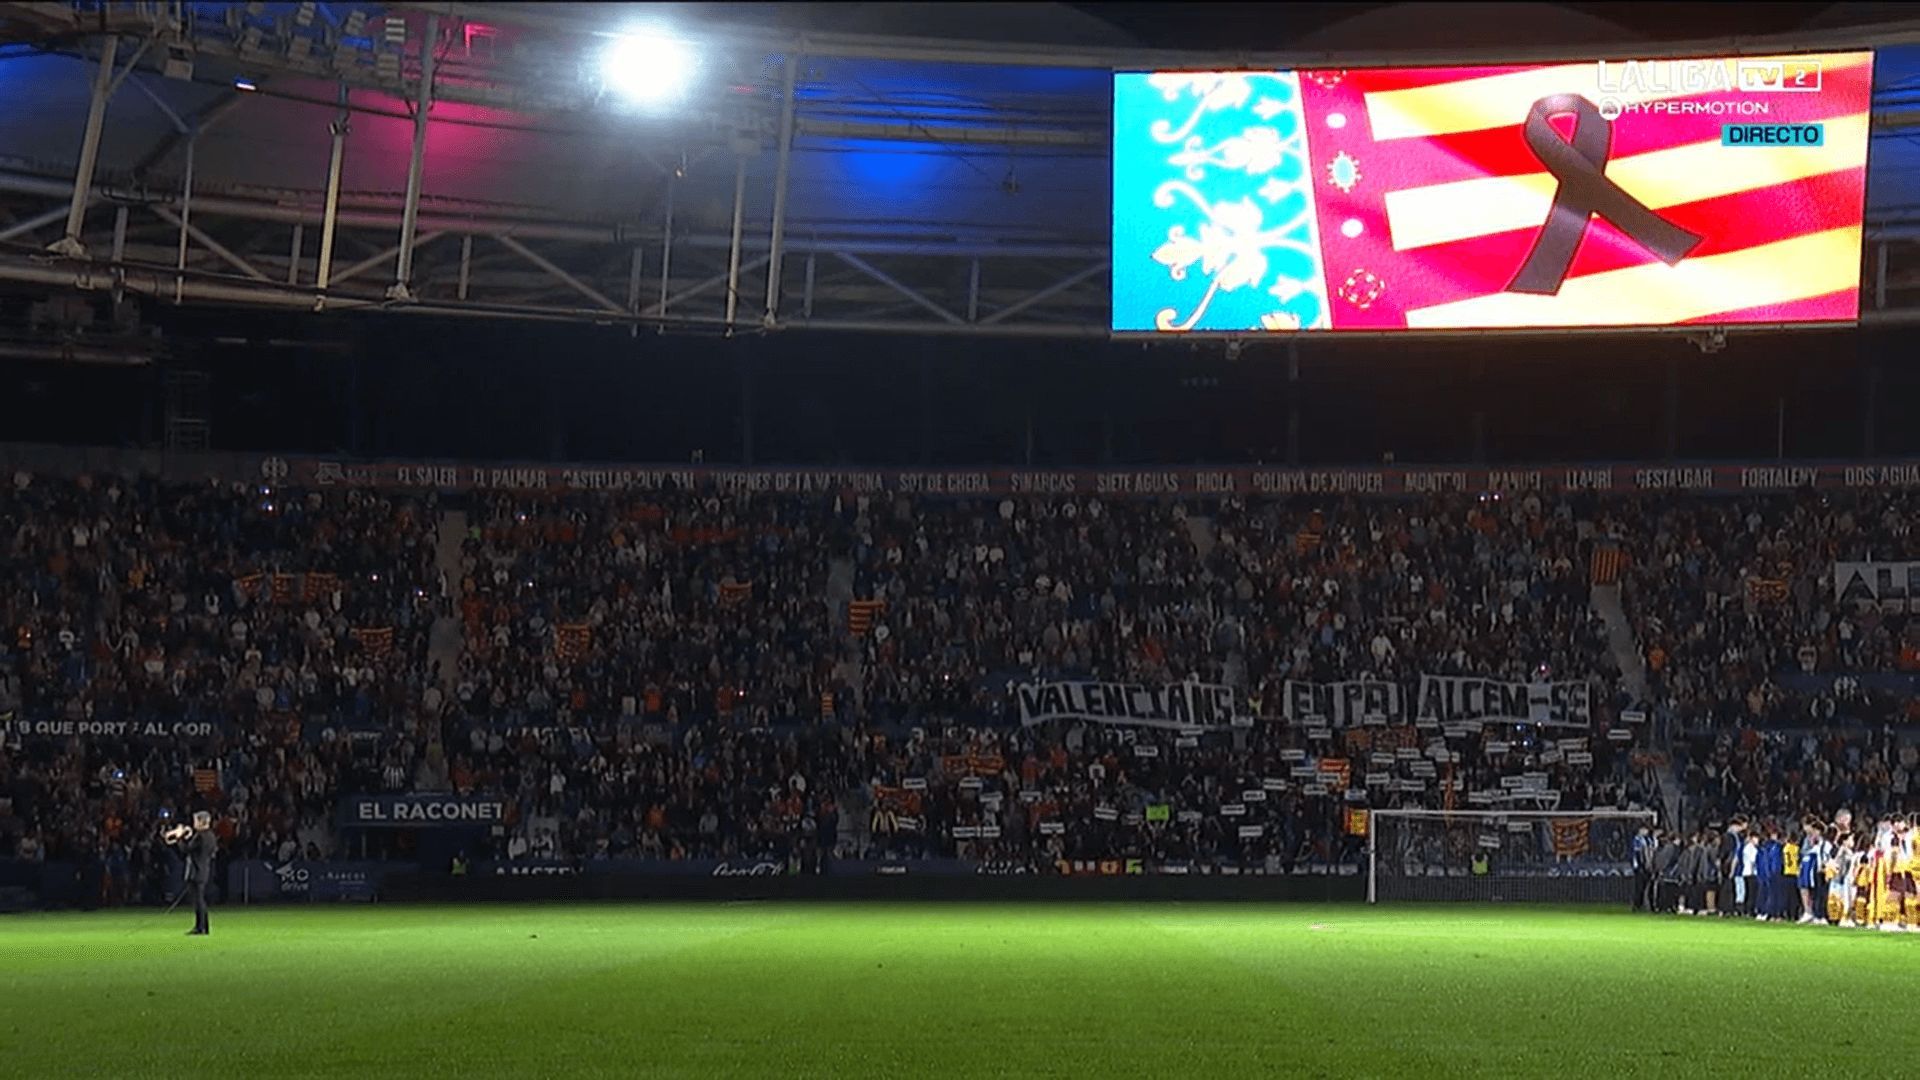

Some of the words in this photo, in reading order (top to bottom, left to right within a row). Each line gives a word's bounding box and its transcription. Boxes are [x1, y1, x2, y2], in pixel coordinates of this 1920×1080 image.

[398, 467, 411, 485] EL
[416, 467, 456, 487] SALER
[492, 468, 547, 488] PALMAR
[899, 473, 923, 491] SOT
[927, 473, 942, 491] DE
[947, 473, 990, 492] CHERA
[1011, 473, 1076, 492] SINARCAS
[1097, 473, 1131, 492] SIETE
[1135, 473, 1179, 492] AGUAS
[1195, 473, 1235, 492] RIOLA
[1635, 468, 1713, 488] GESTALGAR
[1741, 467, 1819, 488] FORTALENY
[1845, 467, 1875, 487] DOS
[35, 721, 74, 735] QUE
[144, 721, 168, 735] AL
[172, 721, 212, 735] COR
[359, 802, 388, 819] EL
[393, 802, 502, 819] RACONET
